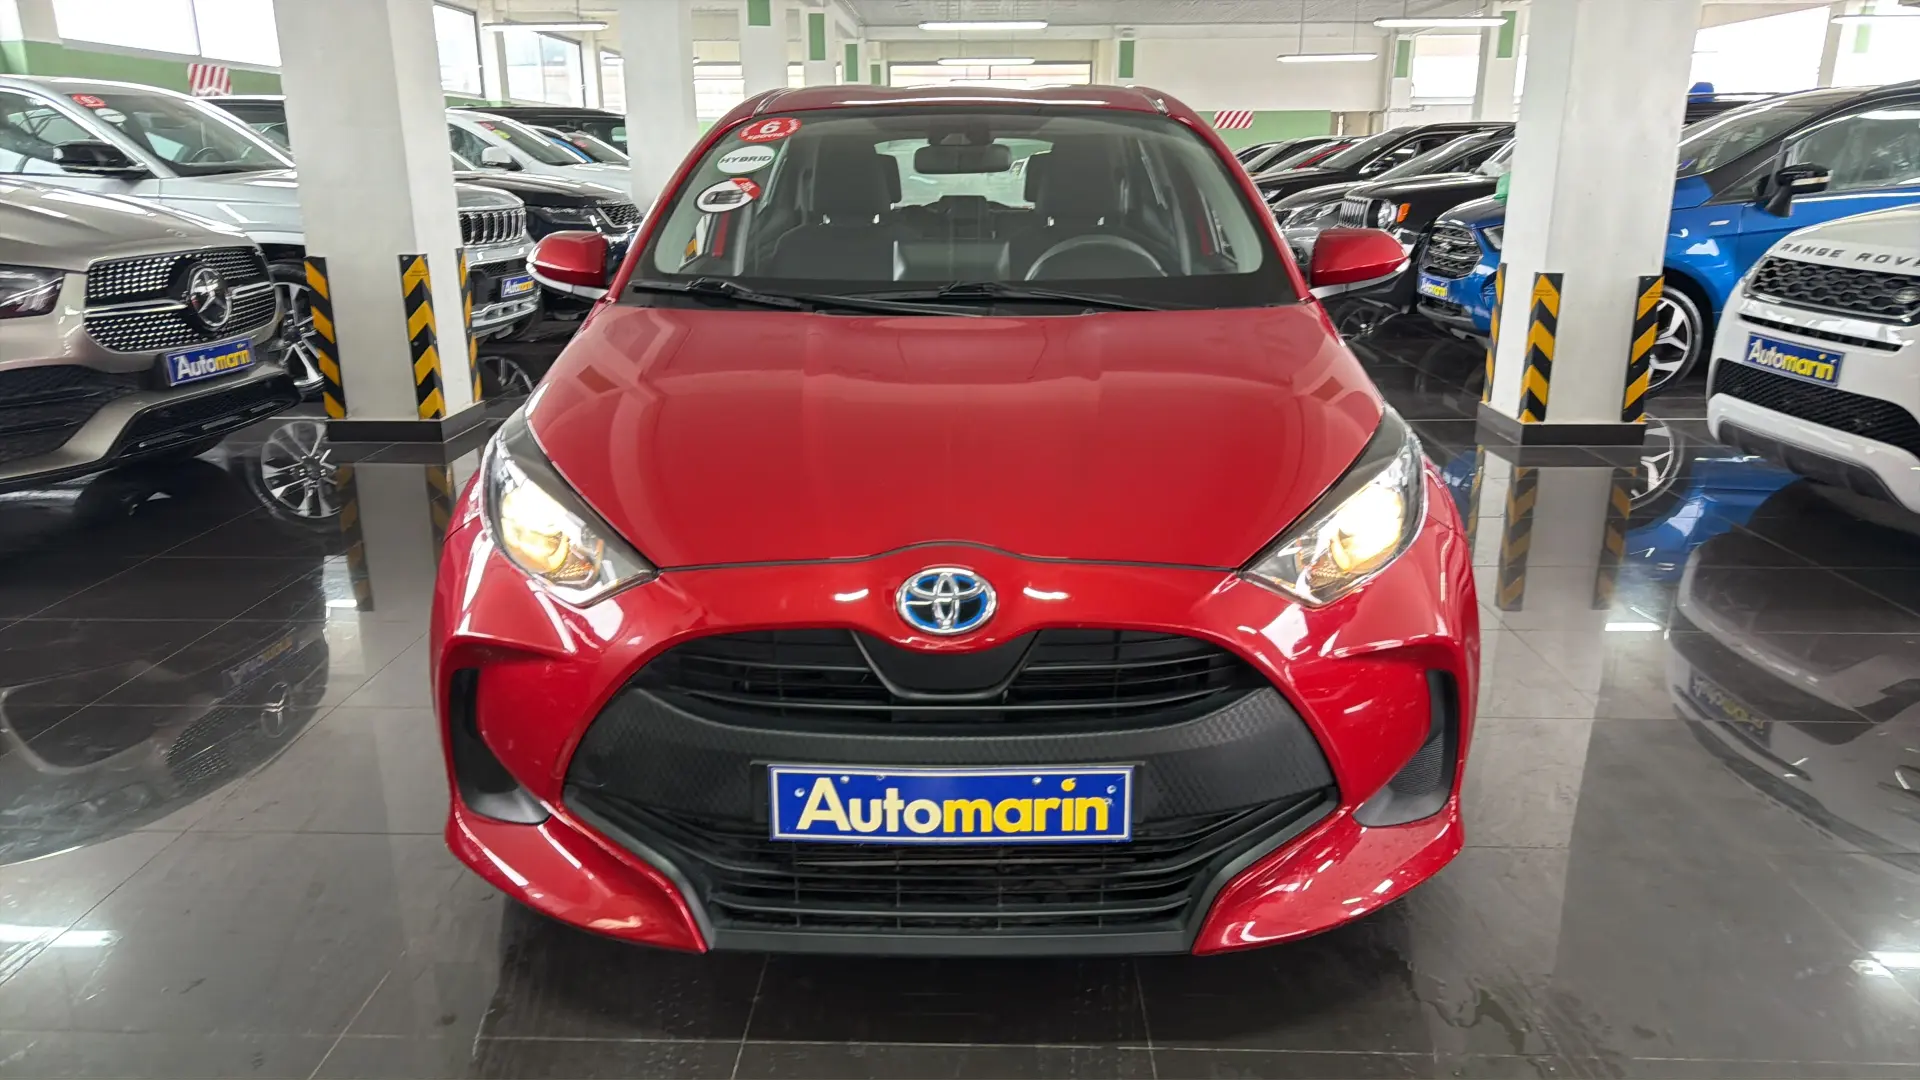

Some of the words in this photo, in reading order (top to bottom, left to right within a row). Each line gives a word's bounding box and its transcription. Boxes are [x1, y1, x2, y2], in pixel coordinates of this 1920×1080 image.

[760, 120, 781, 133] 6
[719, 155, 772, 164] HYBRID
[1780, 243, 1846, 258] RANGE
[173, 343, 251, 380] Automarin
[1747, 338, 1835, 381] Automarin
[796, 777, 1109, 833] Automarin
